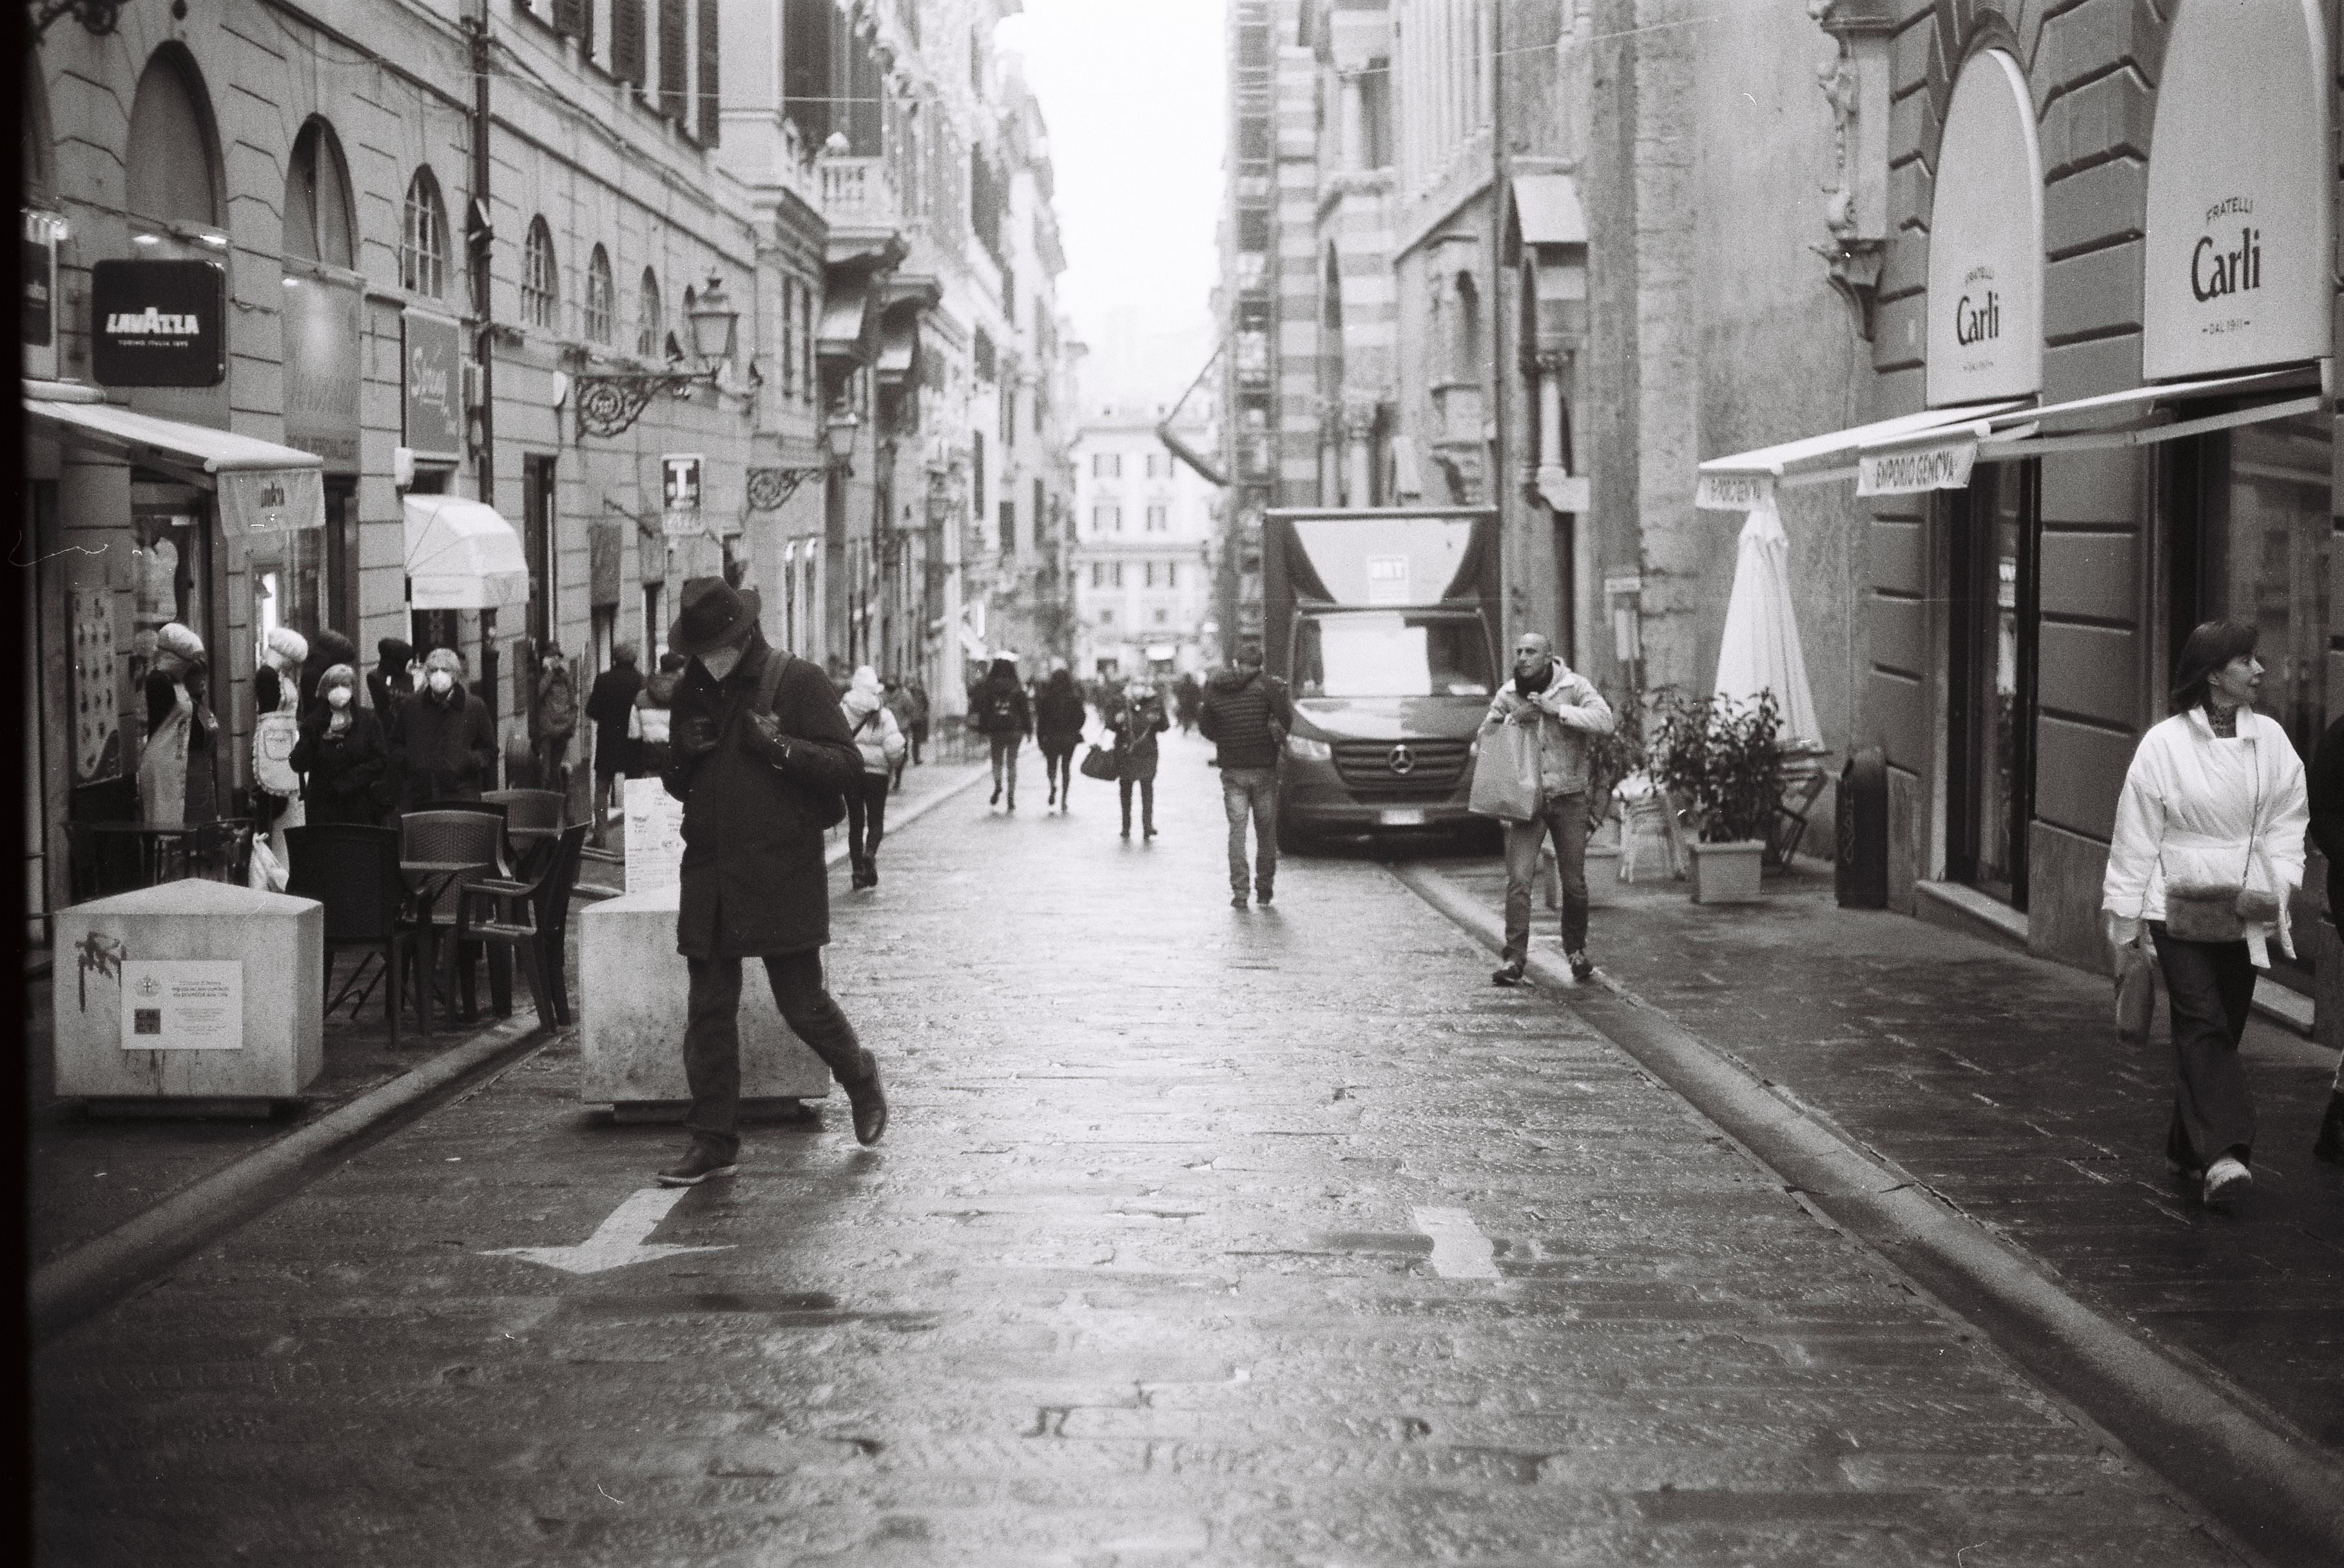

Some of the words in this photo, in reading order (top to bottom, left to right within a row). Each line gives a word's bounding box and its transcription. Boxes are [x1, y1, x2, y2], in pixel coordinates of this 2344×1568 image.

[2206, 197, 2254, 226] FRATELLI
[2191, 227, 2260, 302] Carli
[106, 307, 200, 334] LAVAZZA
[1957, 291, 1999, 346] Carli
